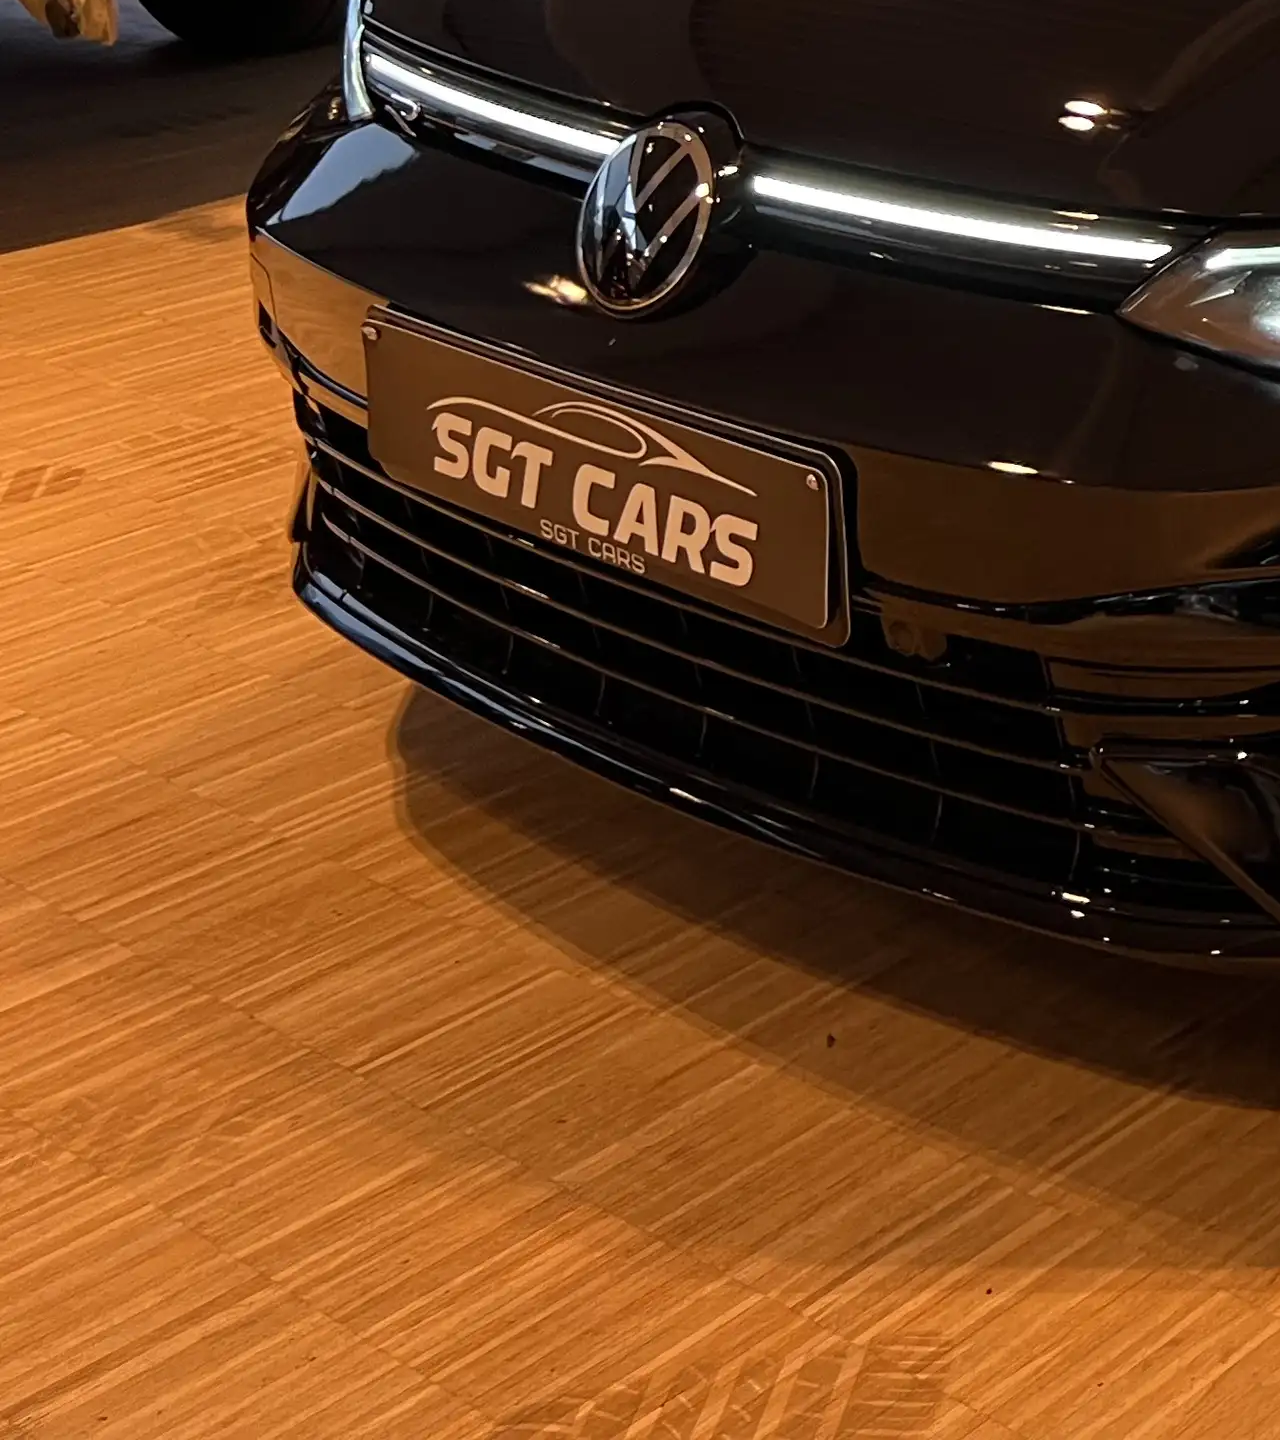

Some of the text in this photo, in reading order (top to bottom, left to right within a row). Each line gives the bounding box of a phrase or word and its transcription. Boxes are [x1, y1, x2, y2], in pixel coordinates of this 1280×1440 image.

[431, 412, 759, 588] SGT CARS
[539, 518, 646, 575] SGT CARS
